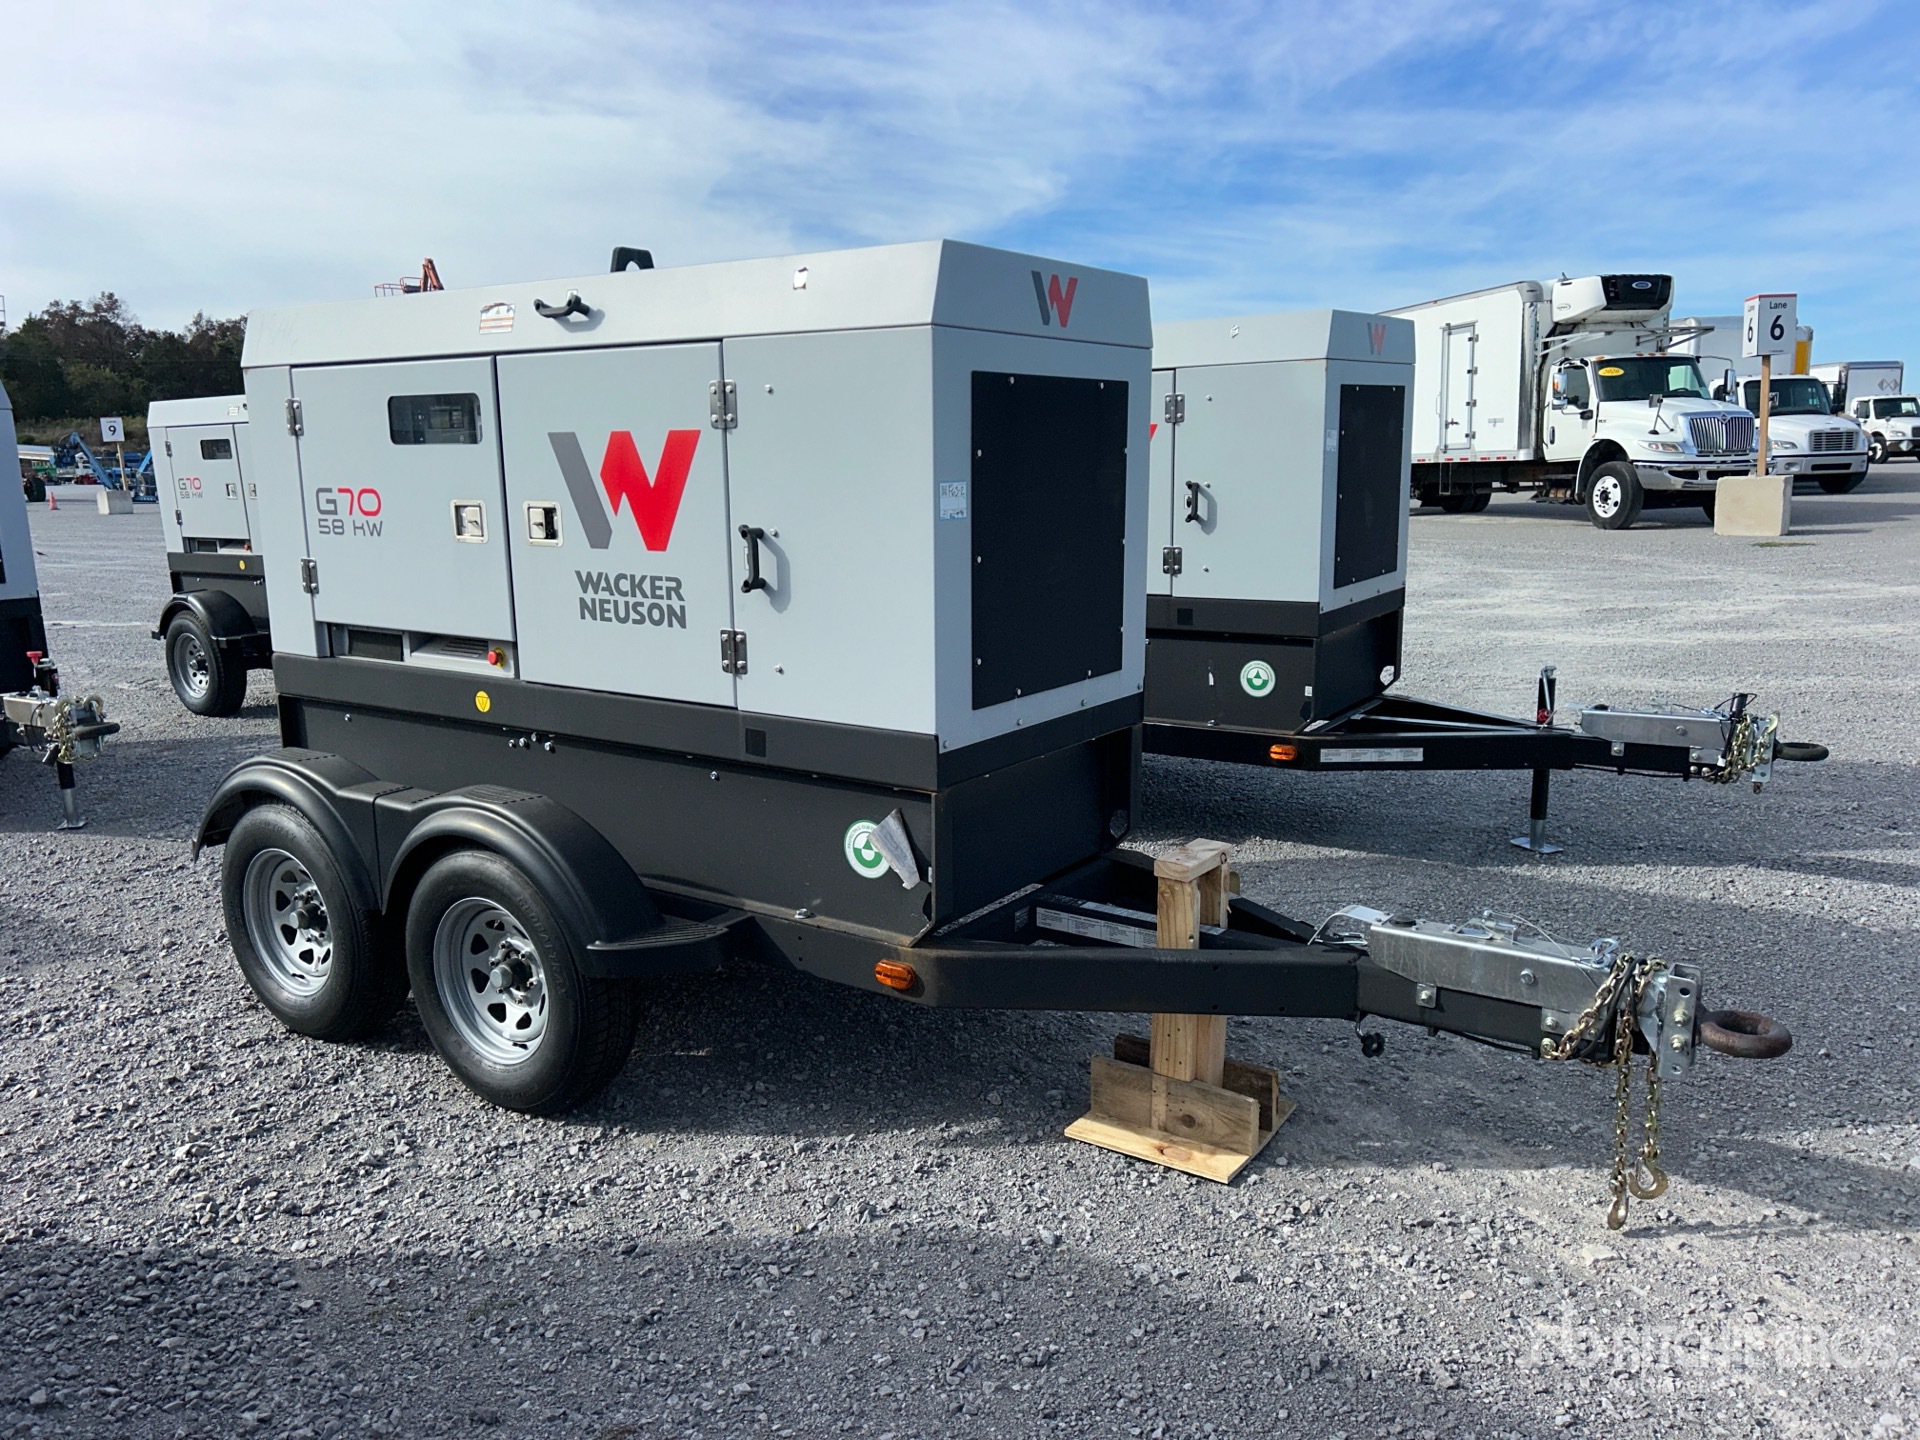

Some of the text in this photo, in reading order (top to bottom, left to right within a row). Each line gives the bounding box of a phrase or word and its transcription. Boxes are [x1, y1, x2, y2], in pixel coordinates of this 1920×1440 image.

[1769, 301, 1787, 310] Lane
[1747, 317, 1754, 343] 6
[1770, 314, 1785, 341] 6
[108, 425, 117, 436] 9
[178, 477, 202, 491] G70
[315, 487, 382, 517] G70
[317, 518, 345, 536] 58
[574, 570, 686, 602] WACKER
[579, 596, 687, 630] NEUSON
